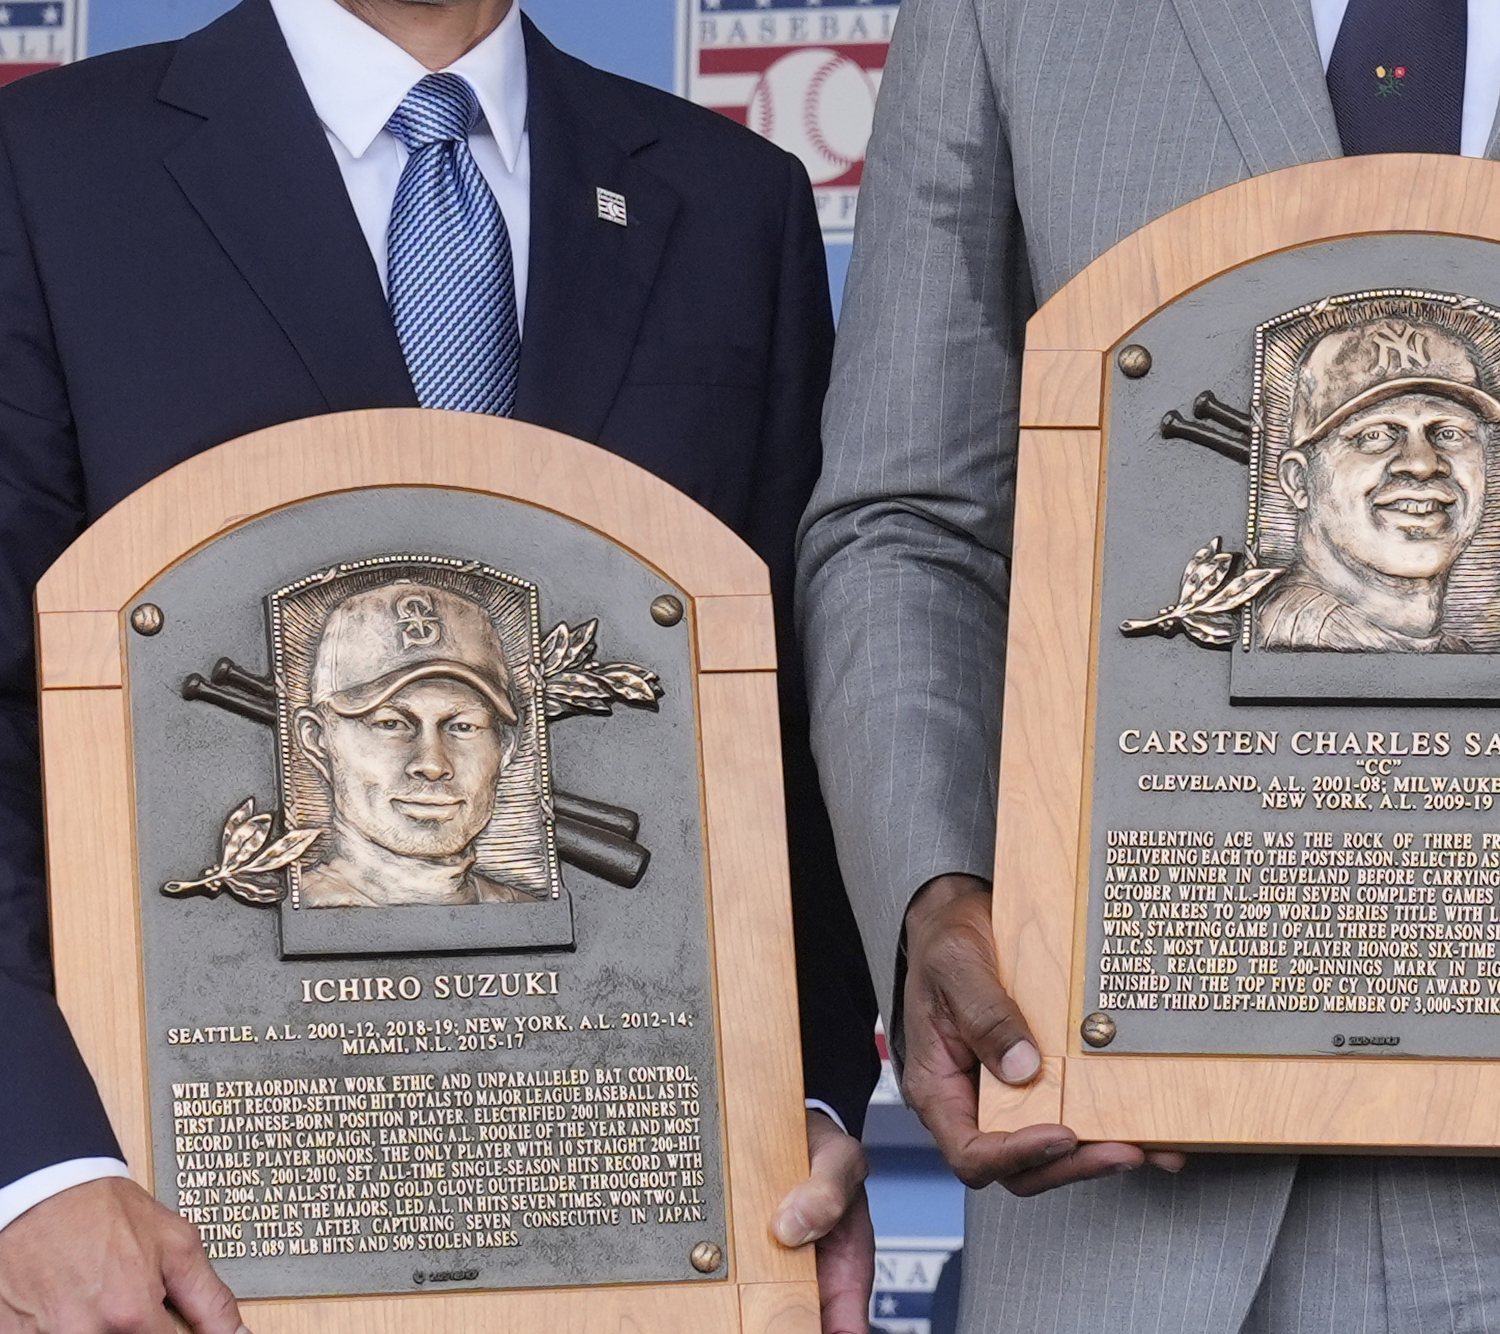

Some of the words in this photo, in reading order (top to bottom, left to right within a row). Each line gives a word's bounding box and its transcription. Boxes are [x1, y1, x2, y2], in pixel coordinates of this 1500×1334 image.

[1118, 730, 1279, 754] CARSTEN
[1291, 731, 1450, 756] CHARLES
[1137, 775, 1262, 793] CLEVELAND,
[1268, 776, 1306, 792] A.L.
[1311, 776, 1387, 794] 2001-08;
[1261, 793, 1306, 808] NEW
[1379, 794, 1417, 809] A.L.
[1423, 794, 1493, 810] 2009-19
[301, 976, 421, 1002] ICHIRO
[434, 972, 559, 998] SUZUKI
[1098, 994, 1159, 1010] BECAME
[1161, 995, 1209, 1010] THIRD
[1212, 995, 1320, 1011] LEFT-HANDED
[1322, 996, 1386, 1012] MEMBER
[1389, 996, 1411, 1013] OF
[168, 1026, 259, 1044] SEATTLE,
[265, 1025, 302, 1041] A.L.
[307, 1022, 381, 1039] 2001-12,
[386, 1020, 459, 1037] 2018-19;
[465, 1018, 508, 1034] NEW
[579, 1015, 615, 1030] A.L.
[341, 1037, 410, 1055] MIAMI,
[414, 1036, 452, 1052] N.L.
[457, 1033, 529, 1051] 2015-17
[170, 1082, 210, 1099] WITH
[215, 1077, 338, 1098] EXTRAORDINARY
[343, 1076, 387, 1093] WORK
[392, 1074, 435, 1092] ETHIC
[441, 1073, 472, 1090] AND
[477, 1069, 590, 1089] UNPARALLELED
[595, 1068, 622, 1084] BAT
